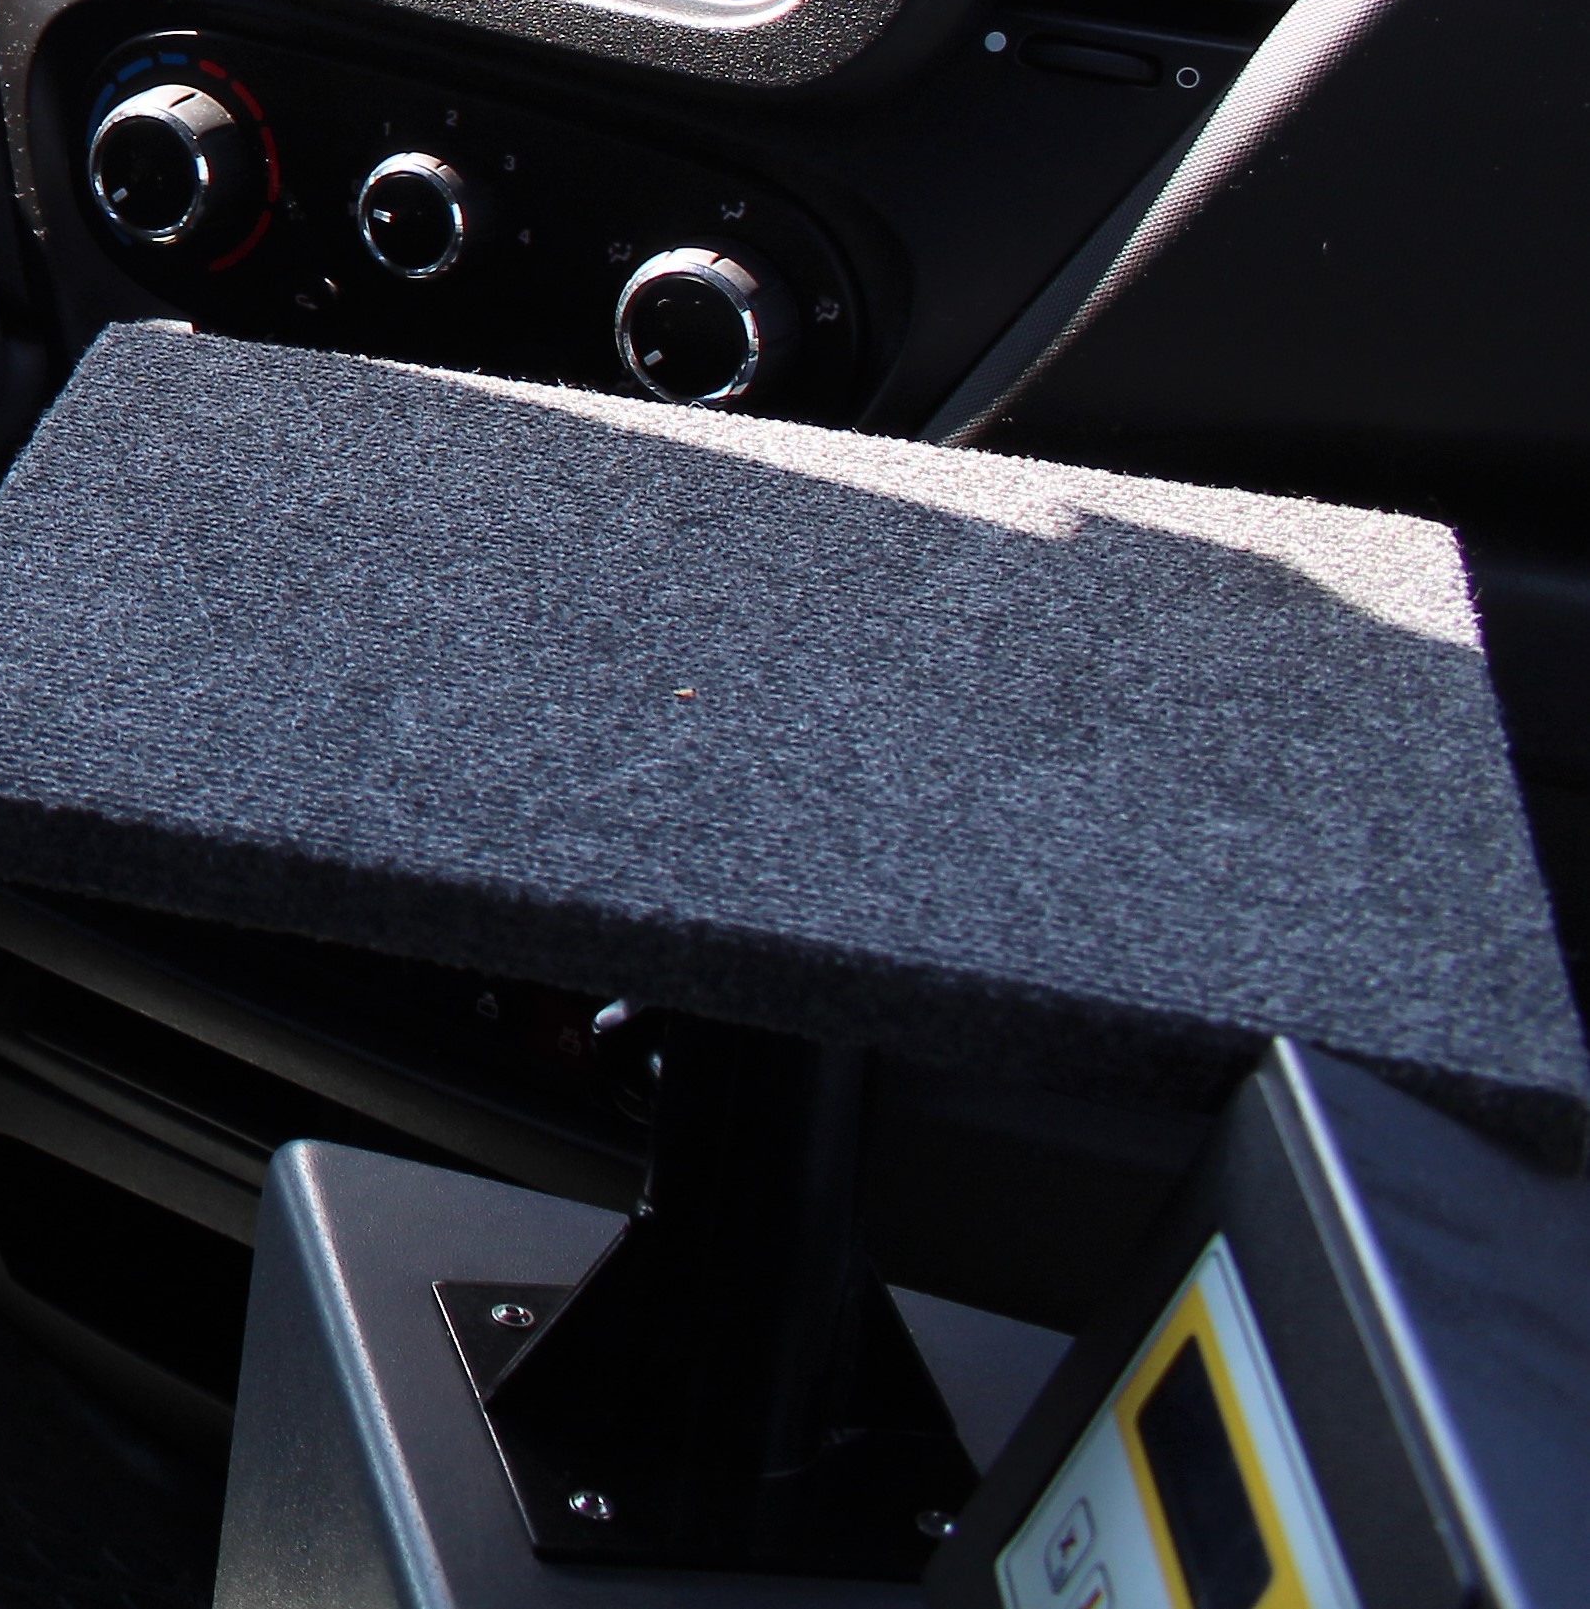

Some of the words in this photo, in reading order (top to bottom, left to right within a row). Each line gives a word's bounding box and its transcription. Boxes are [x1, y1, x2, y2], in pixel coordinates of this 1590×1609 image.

[445, 110, 459, 127] 2
[383, 122, 392, 137] 1
[503, 154, 517, 171] 3
[519, 228, 532, 246] 4
